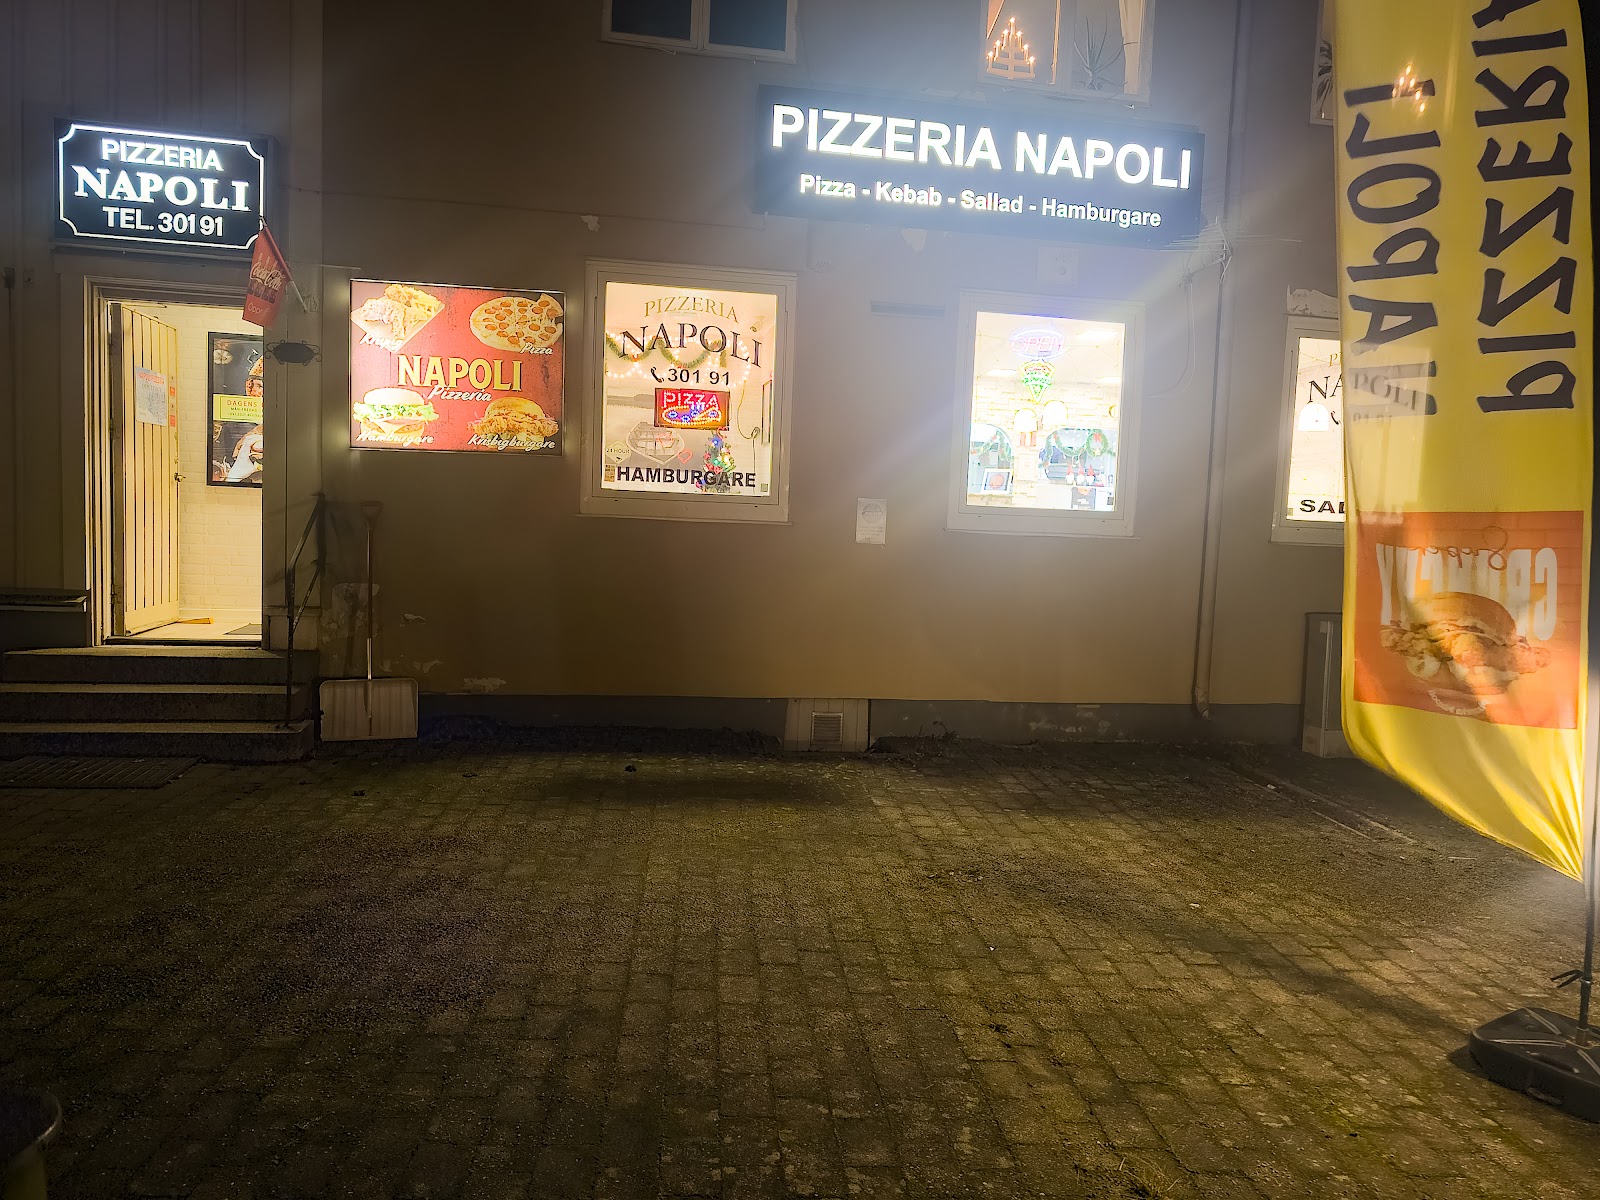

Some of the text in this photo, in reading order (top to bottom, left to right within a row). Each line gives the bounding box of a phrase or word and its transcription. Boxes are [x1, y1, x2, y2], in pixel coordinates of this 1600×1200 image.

[101, 138, 224, 171] PIZZERIA
[772, 104, 1192, 190] PIZZERIA NAPOLI
[71, 165, 250, 211] NAPOLI
[800, 173, 857, 198] Pizza
[875, 181, 943, 207] Kebab
[960, 189, 1024, 214] Sallad
[1042, 198, 1161, 228] Hamburgare
[102, 206, 224, 237] TEL. 301 91
[644, 295, 739, 324] PIZZERIA
[520, 342, 553, 355] Pizza
[618, 322, 763, 368] NAPOLI
[1011, 336, 1065, 352] OPEN
[397, 354, 523, 392] NAPOLI
[667, 368, 730, 386] 301 91
[427, 385, 492, 401] Pizzeria
[662, 390, 719, 411] PIZZA
[356, 430, 434, 446] Hamburgare
[617, 466, 756, 488] HAMBURGARE
